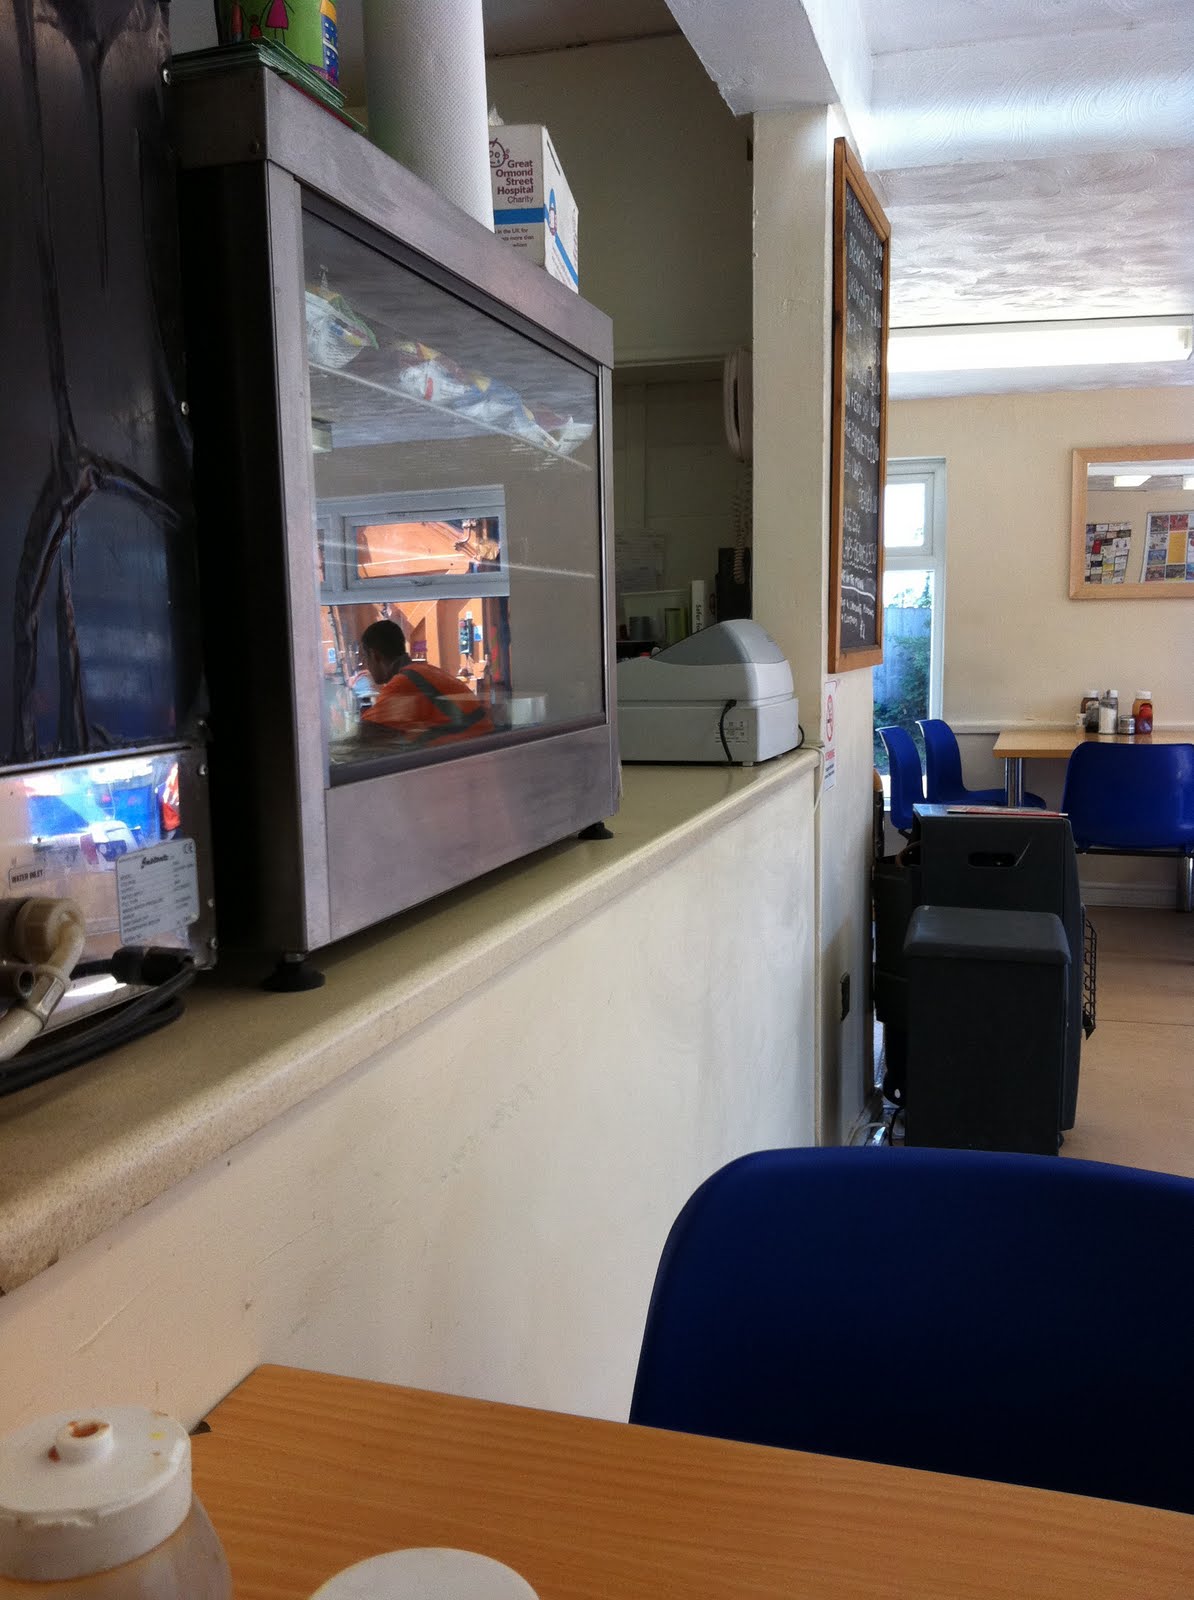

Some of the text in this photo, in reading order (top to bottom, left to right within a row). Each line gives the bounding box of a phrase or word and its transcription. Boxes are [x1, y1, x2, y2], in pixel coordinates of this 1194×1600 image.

[507, 160, 533, 168] Great
[495, 168, 533, 178] Ormond
[506, 177, 534, 186] Street
[497, 186, 534, 196] Hospital
[507, 195, 534, 204] Charity
